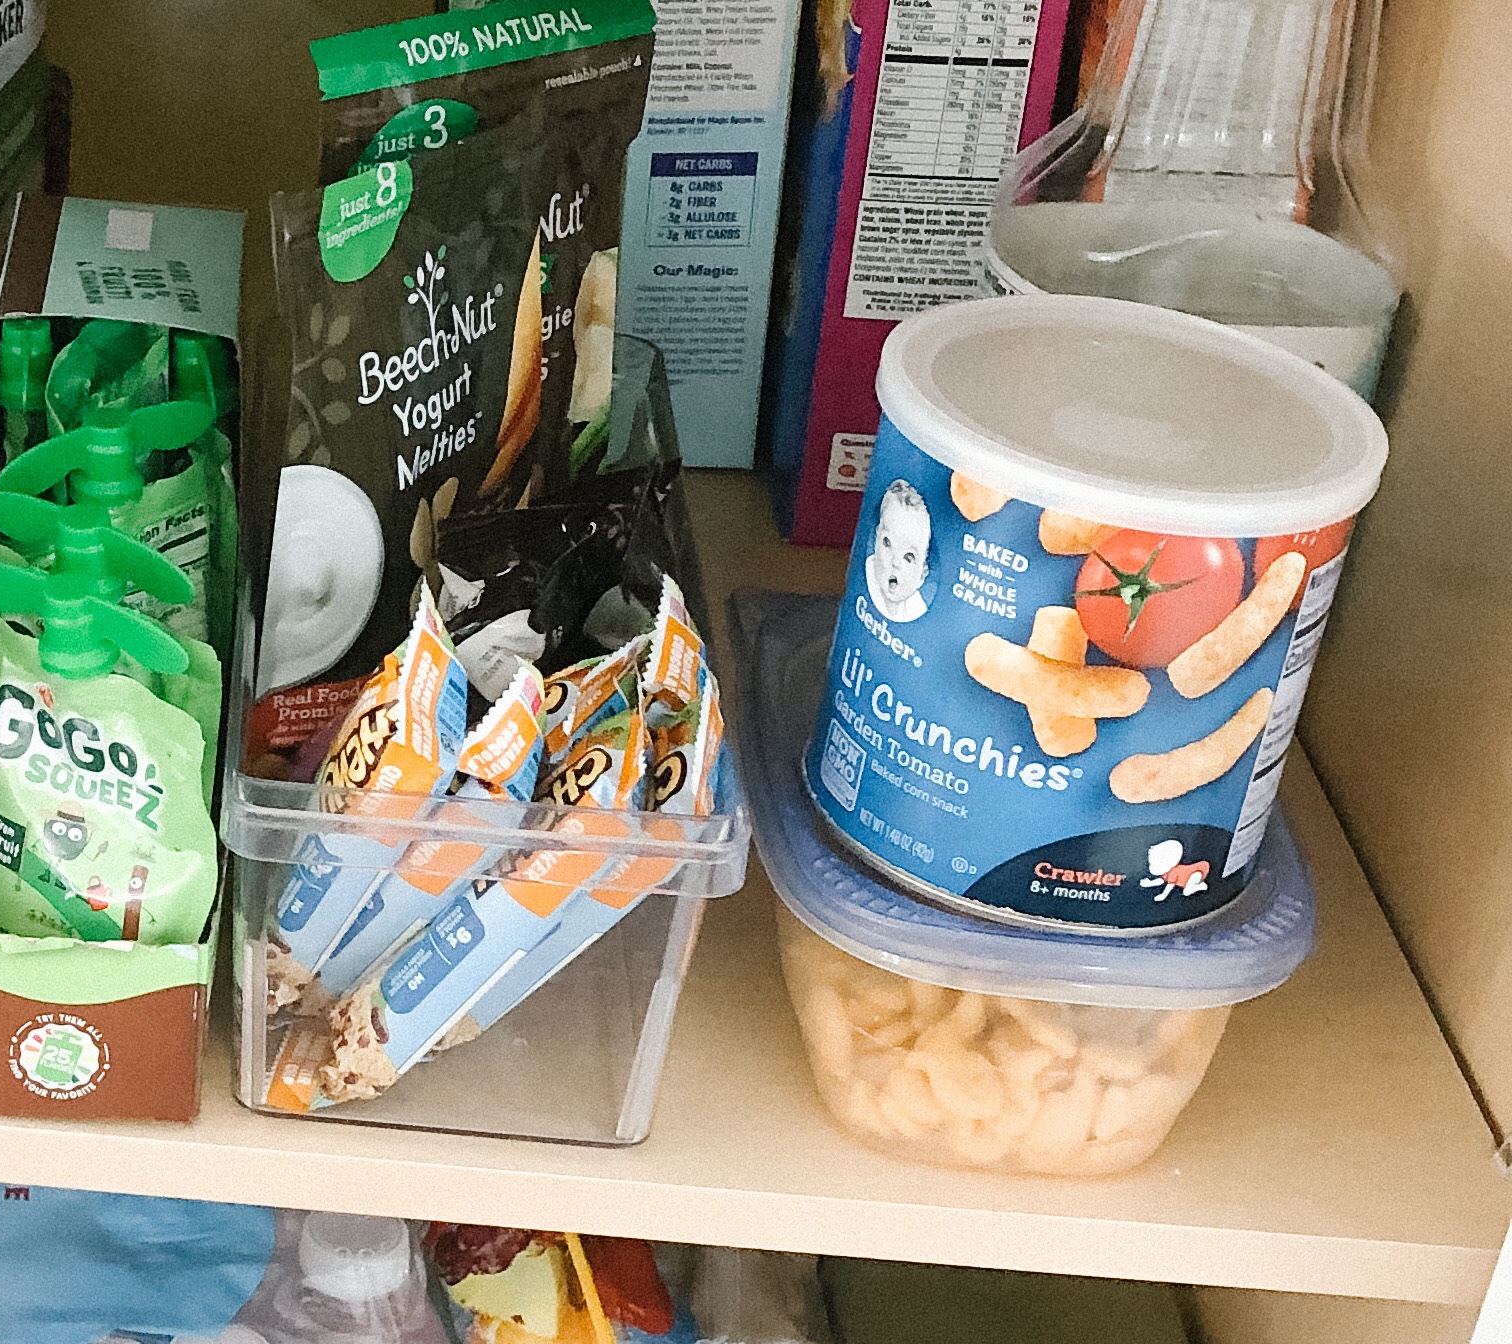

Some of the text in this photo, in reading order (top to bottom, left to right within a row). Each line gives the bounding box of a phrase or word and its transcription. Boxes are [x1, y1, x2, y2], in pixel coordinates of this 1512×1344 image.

[398, 8, 593, 68] 100% NATURAL
[375, 105, 449, 160] just 3
[674, 158, 734, 171] NET CARBS
[337, 163, 397, 226] just 8
[687, 196, 718, 208] FIBER
[688, 180, 724, 193] CARBS
[683, 228, 741, 240] NET CARBS
[685, 211, 738, 223] ALLULOSE
[652, 264, 739, 279] Our Magic:
[357, 288, 499, 405] Beech-Nut
[392, 362, 473, 436] Yogurt
[396, 421, 479, 492] Melties
[962, 533, 1029, 575] BAKED
[978, 558, 1004, 582] with
[952, 582, 1018, 619] GRAINS
[958, 566, 1018, 603] WHOLE
[855, 596, 914, 667] Gerber
[272, 682, 362, 711] Real Food
[831, 725, 864, 763] NON
[833, 689, 970, 796] Garden Tomato
[870, 683, 1074, 793] Crunchies
[827, 747, 858, 785] GMO
[869, 758, 970, 820] Baked corn snack
[1029, 879, 1111, 903] 8+ months
[1033, 861, 1126, 888] Crawler
[35, 1013, 87, 1028] TRY THEM
[49, 1081, 98, 1100] FAVORITE
